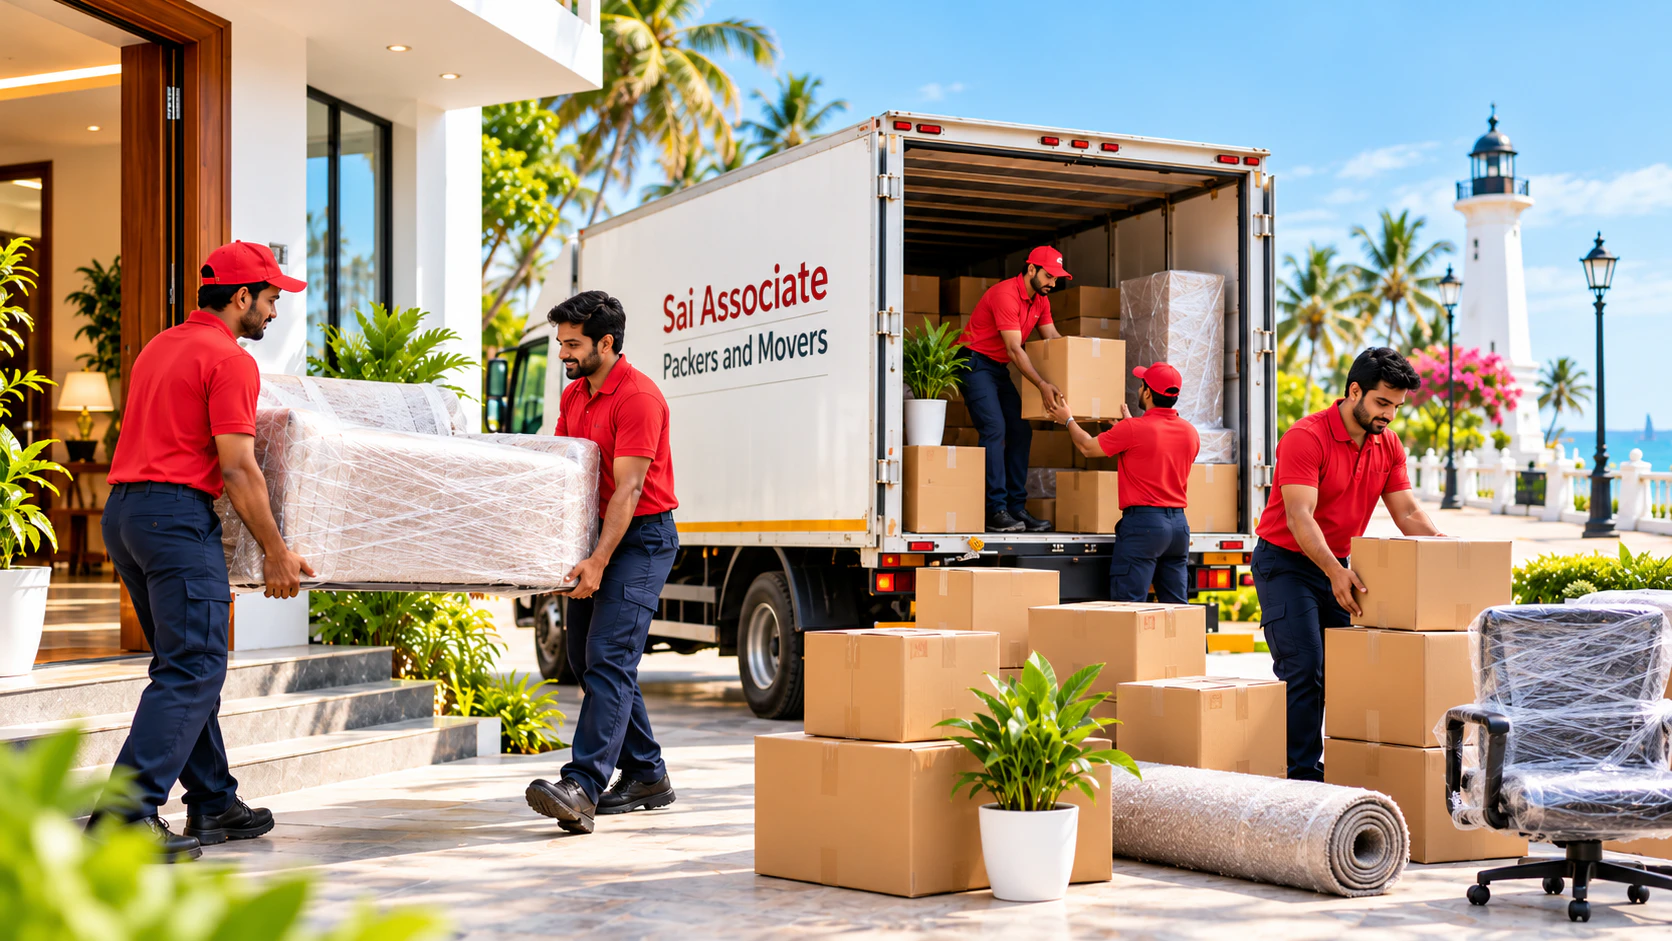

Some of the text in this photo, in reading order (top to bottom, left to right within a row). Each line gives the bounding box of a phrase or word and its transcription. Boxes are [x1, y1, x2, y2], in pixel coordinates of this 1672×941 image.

[664, 261, 829, 334] Sai Associate
[664, 328, 828, 380] Packers and Movers
